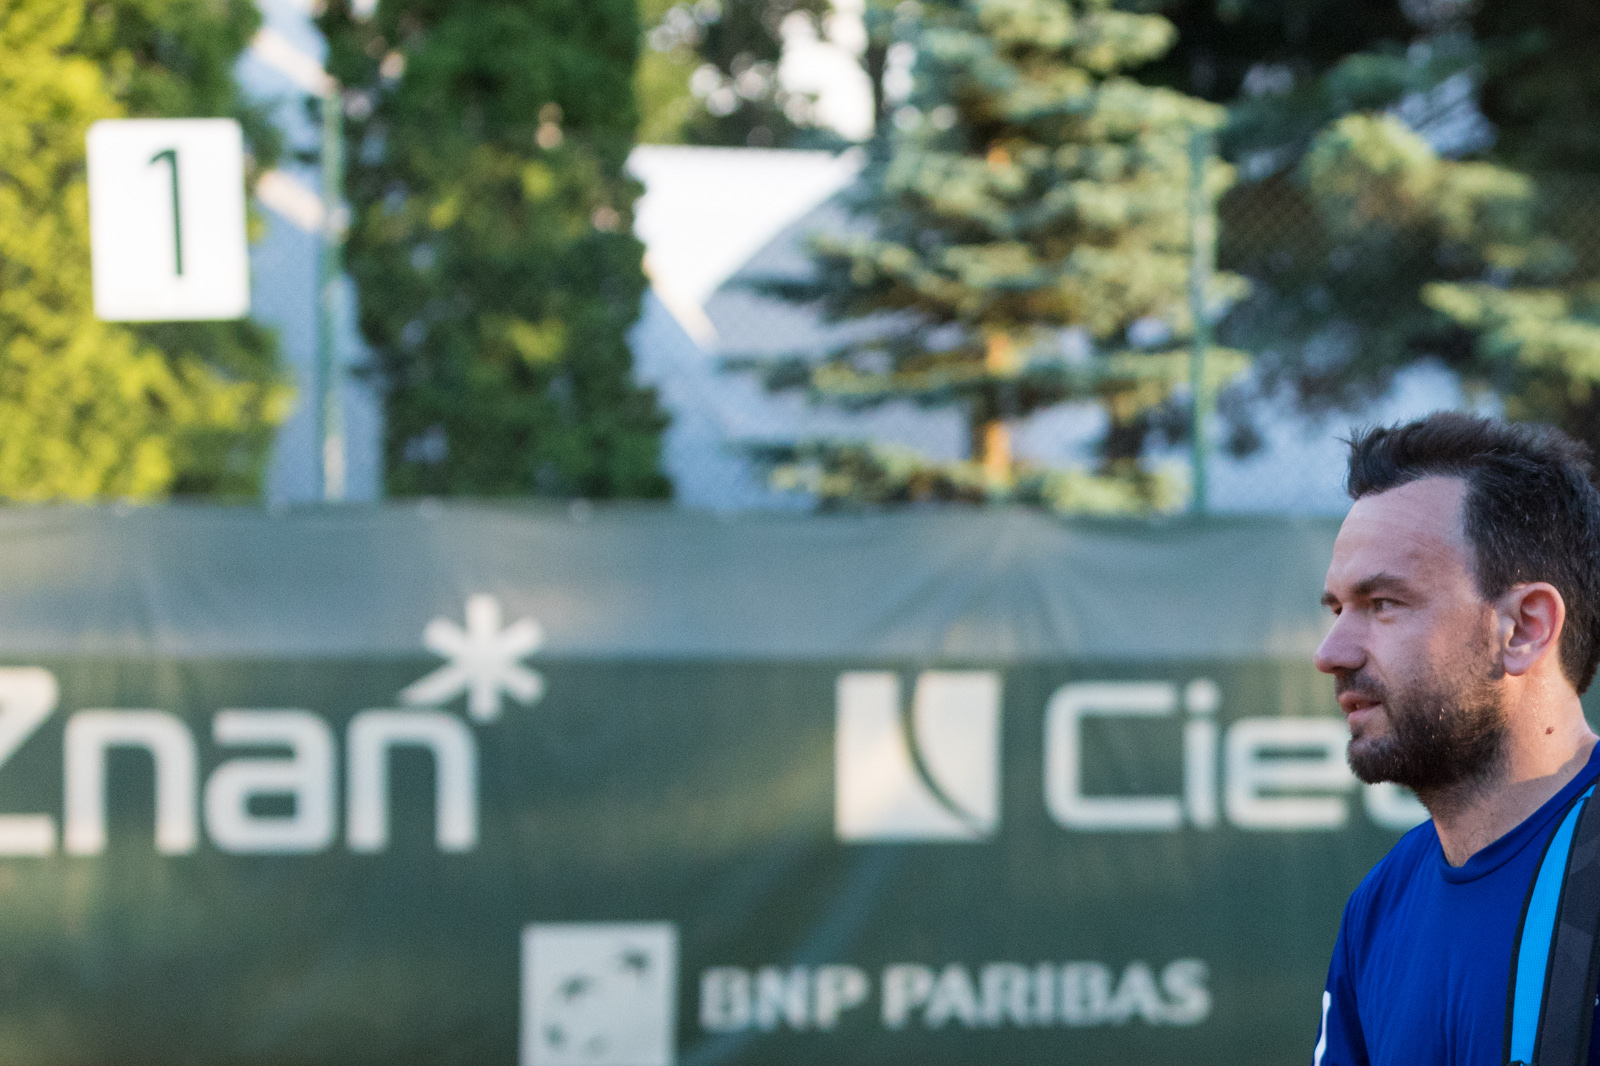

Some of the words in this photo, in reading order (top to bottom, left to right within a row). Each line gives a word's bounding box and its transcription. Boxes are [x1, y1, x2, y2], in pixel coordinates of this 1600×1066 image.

[147, 148, 184, 278] 1
[1043, 678, 1432, 832] Cie
[700, 965, 869, 1031] BNP
[881, 957, 1212, 1030] PARIBAS
